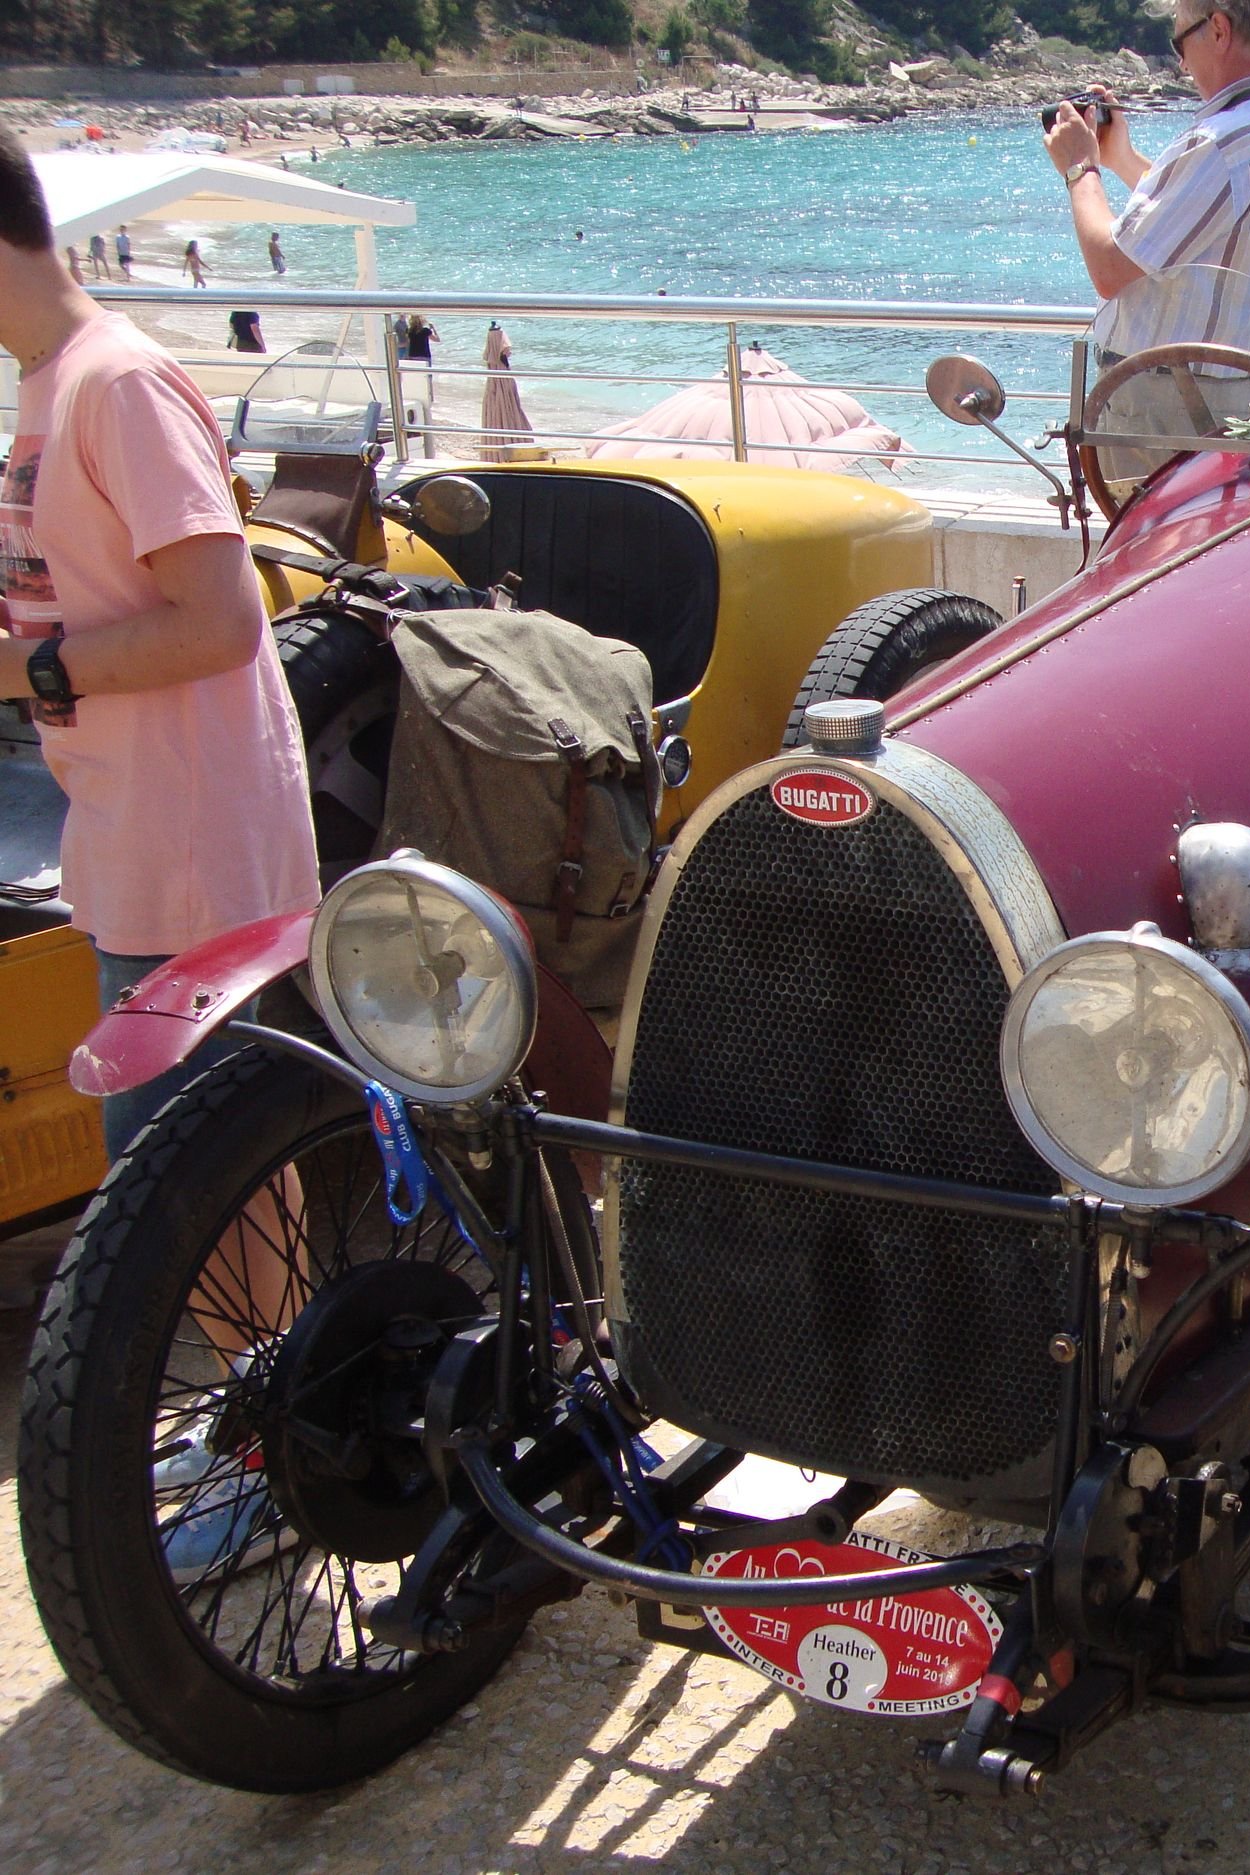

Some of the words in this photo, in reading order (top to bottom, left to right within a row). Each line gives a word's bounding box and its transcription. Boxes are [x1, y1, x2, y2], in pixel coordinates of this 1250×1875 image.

[780, 786, 861, 814] BUGATTI
[397, 1123, 412, 1152] CLUB
[847, 1532, 891, 1555] ATTI
[877, 1596, 968, 1647] Provence
[813, 1632, 877, 1661] Heather
[905, 1646, 914, 1658] 7
[916, 1652, 932, 1664] au
[935, 1655, 949, 1668] 14
[732, 1640, 785, 1682] INTER
[895, 1661, 920, 1677] juin
[826, 1661, 849, 1700] 8
[878, 1695, 960, 1714] MEETING
